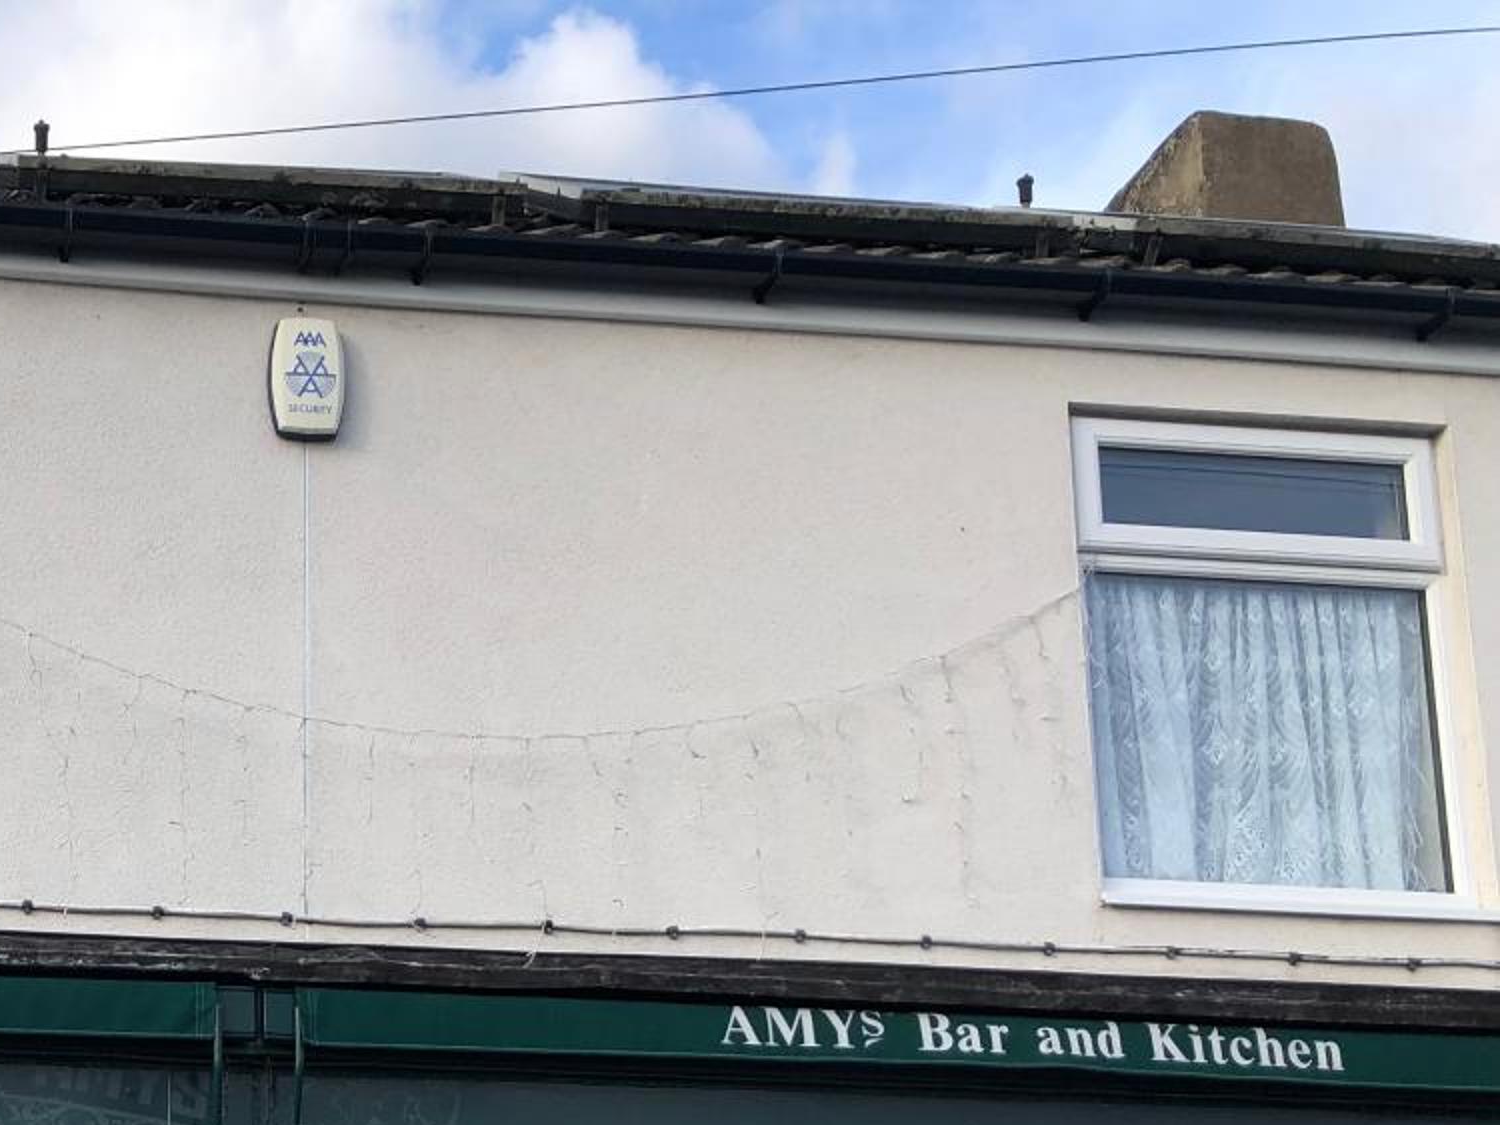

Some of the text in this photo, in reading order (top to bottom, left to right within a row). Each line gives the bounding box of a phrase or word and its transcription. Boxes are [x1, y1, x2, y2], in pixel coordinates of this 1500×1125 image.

[288, 402, 333, 415] SECURITY
[917, 1012, 1009, 1054] Bar
[1036, 1021, 1125, 1059] and
[1147, 1023, 1345, 1071] Kitchen
